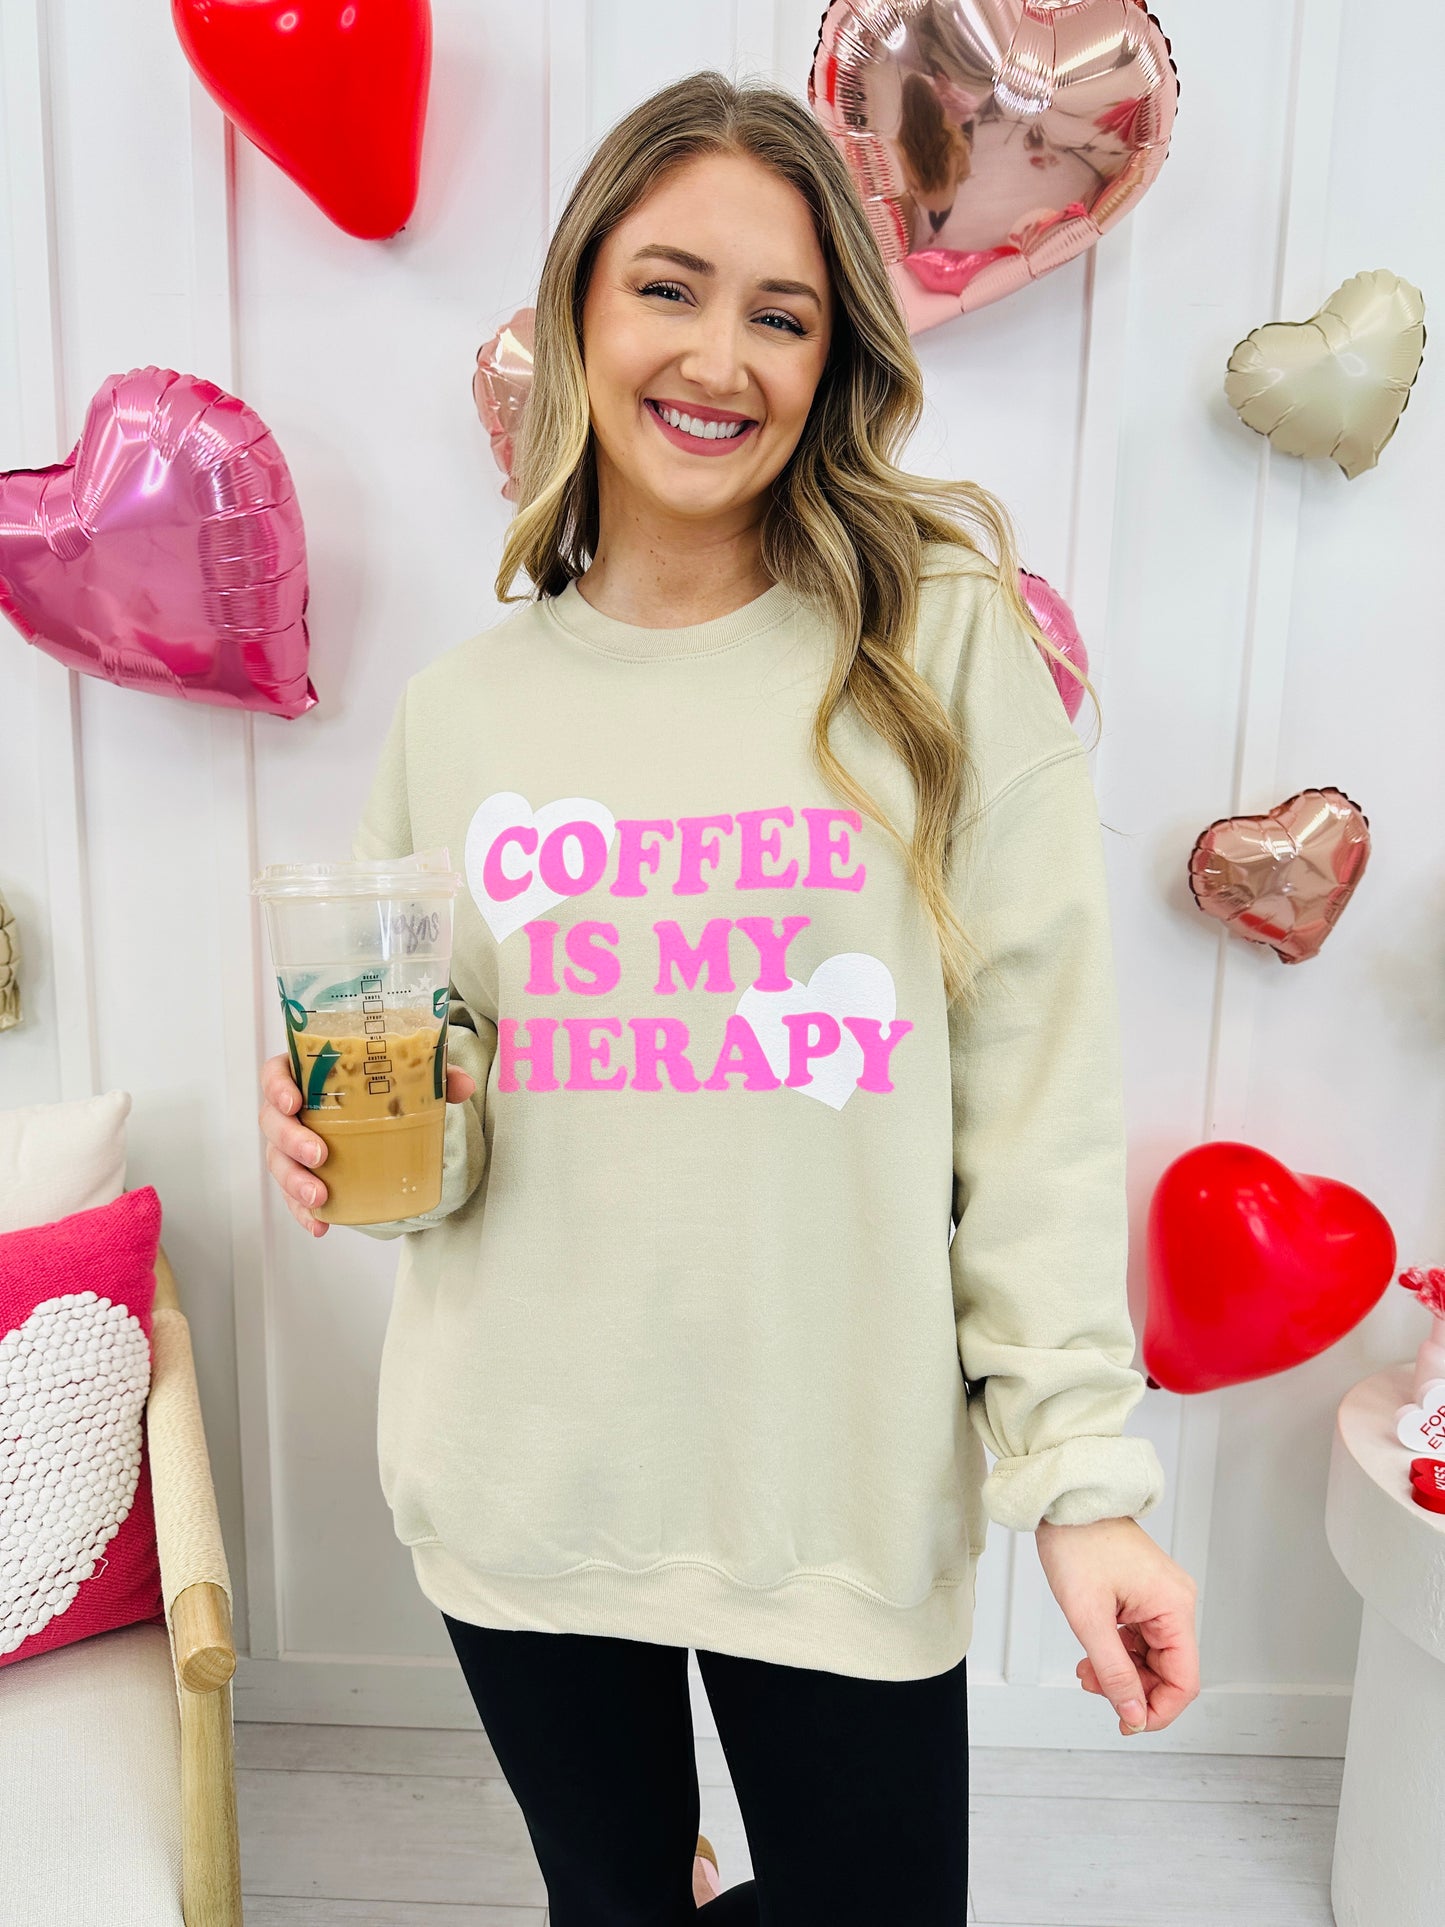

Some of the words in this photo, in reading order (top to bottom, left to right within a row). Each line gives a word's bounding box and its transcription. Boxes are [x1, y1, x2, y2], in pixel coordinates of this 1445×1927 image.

[483, 805, 867, 902] COFFEE
[522, 919, 622, 997] IS
[652, 915, 812, 996] MY
[497, 1011, 915, 1095] HERAPY
